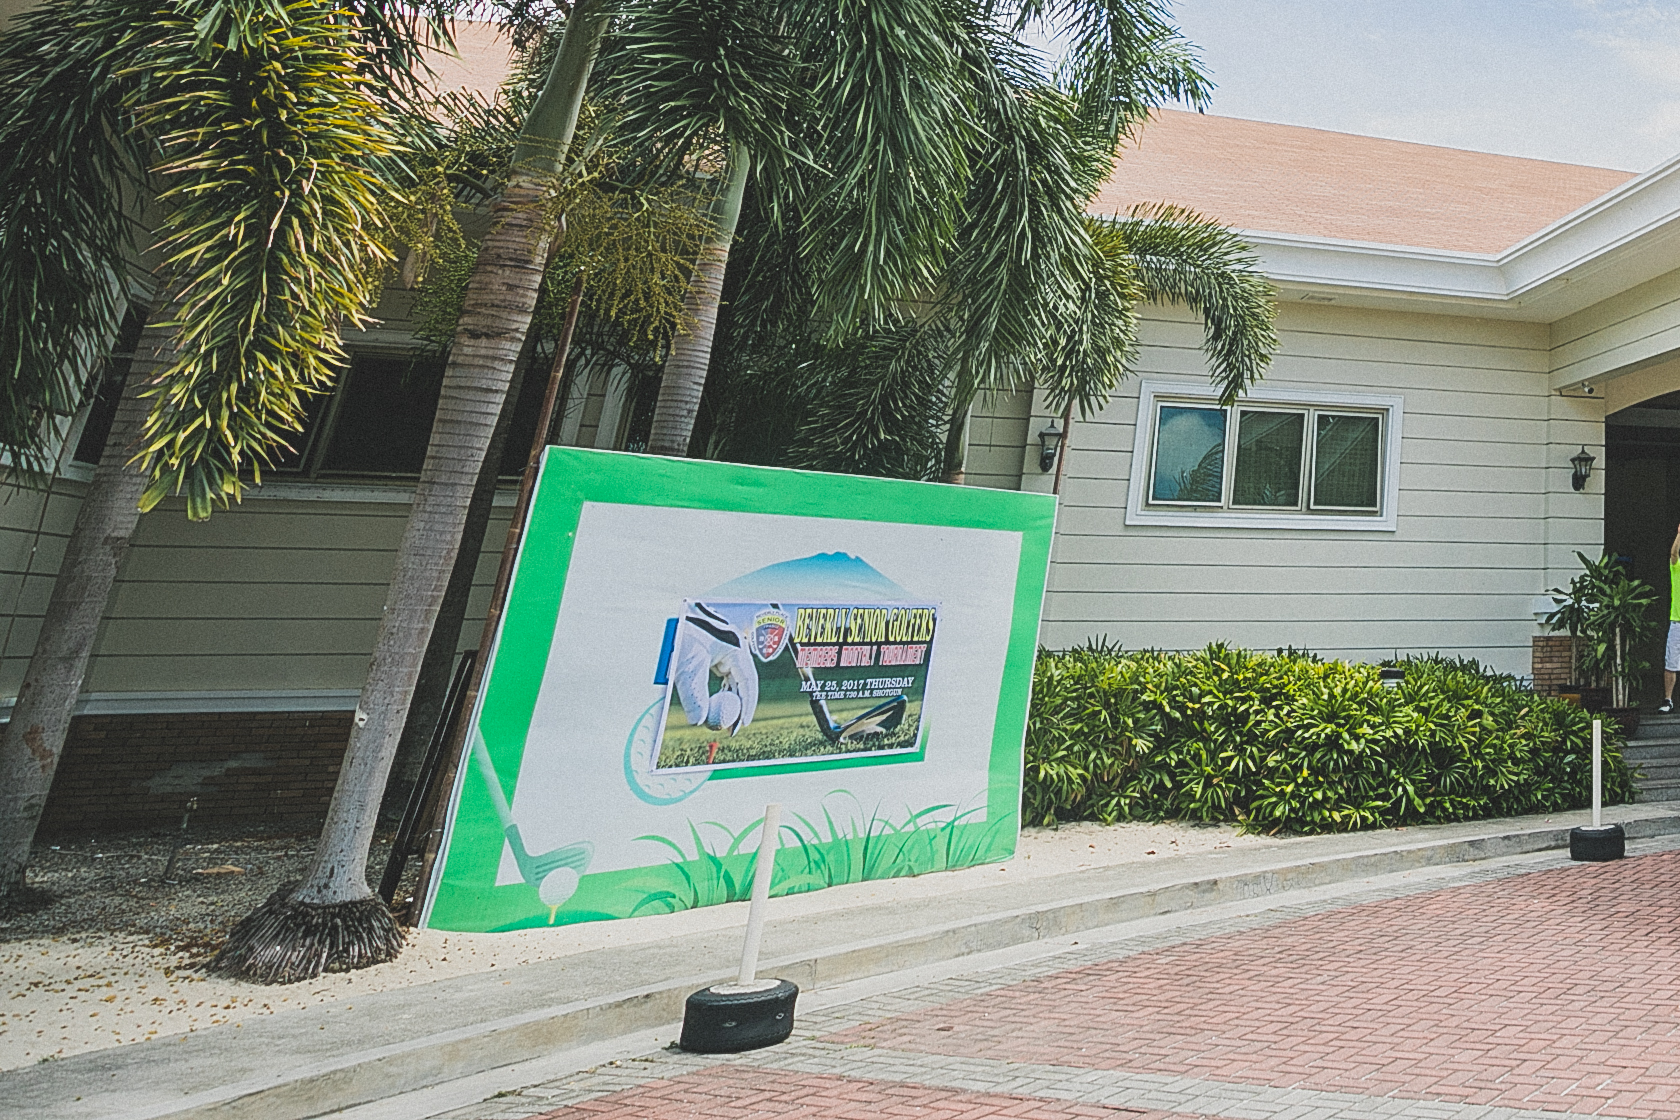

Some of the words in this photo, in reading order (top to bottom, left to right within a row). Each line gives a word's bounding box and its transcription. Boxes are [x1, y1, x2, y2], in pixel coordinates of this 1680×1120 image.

[757, 617, 785, 625] SENIOR
[793, 608, 850, 643] BEVERLY
[847, 608, 888, 643] SENIOR
[888, 607, 936, 642] GOLFERS
[796, 646, 839, 668] MEMBERS
[840, 645, 877, 667] MONTHLY
[879, 644, 927, 666] TOURNAMENT
[800, 680, 824, 692] MAY
[825, 680, 839, 691] 25,
[841, 679, 864, 691] 2017
[865, 677, 915, 689] THURSDAY
[812, 691, 826, 700] TEE
[827, 691, 844, 699] TIME
[857, 690, 871, 698] A.M.
[872, 688, 902, 697] SHOTGUN
